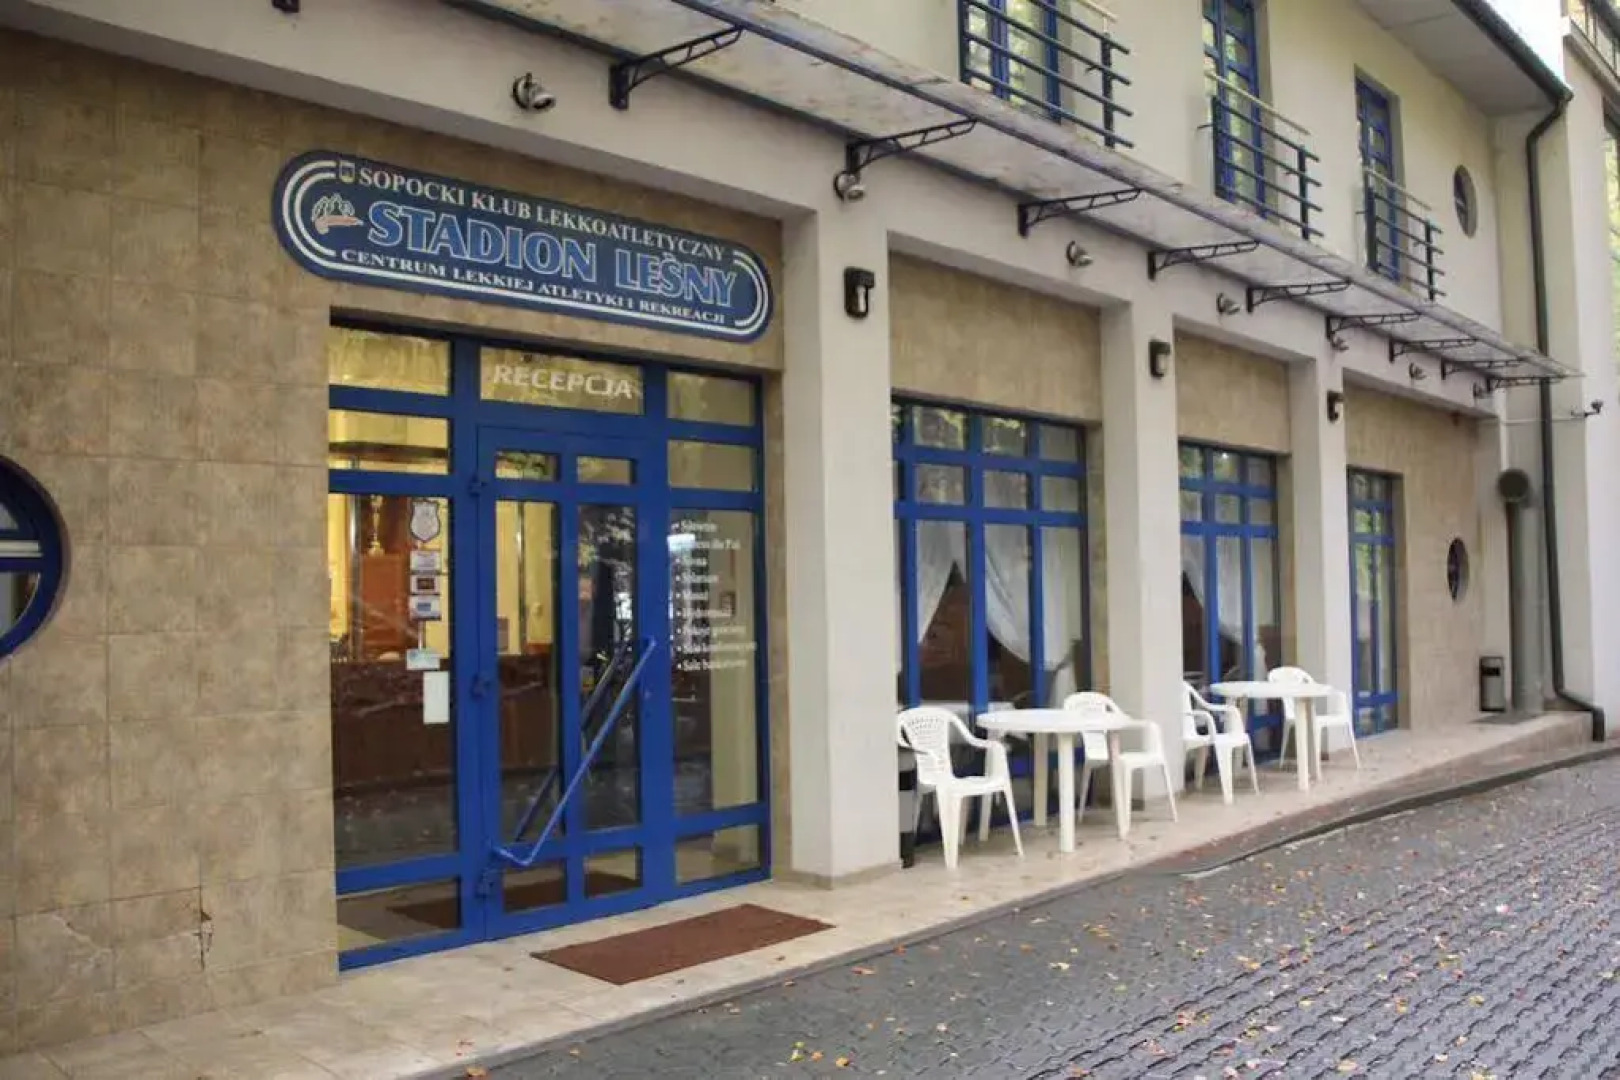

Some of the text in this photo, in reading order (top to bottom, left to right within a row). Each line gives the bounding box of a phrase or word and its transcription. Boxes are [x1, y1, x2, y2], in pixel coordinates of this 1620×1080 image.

[359, 167, 726, 262] SOPOCKI KLUB LEKKOATLETYCZNY
[368, 200, 737, 308] STADION LEŚNY
[341, 249, 726, 325] CENTRUM LEKKIEJ ATLETYKI I REKREACJI
[494, 364, 633, 400] RECEPCJA
